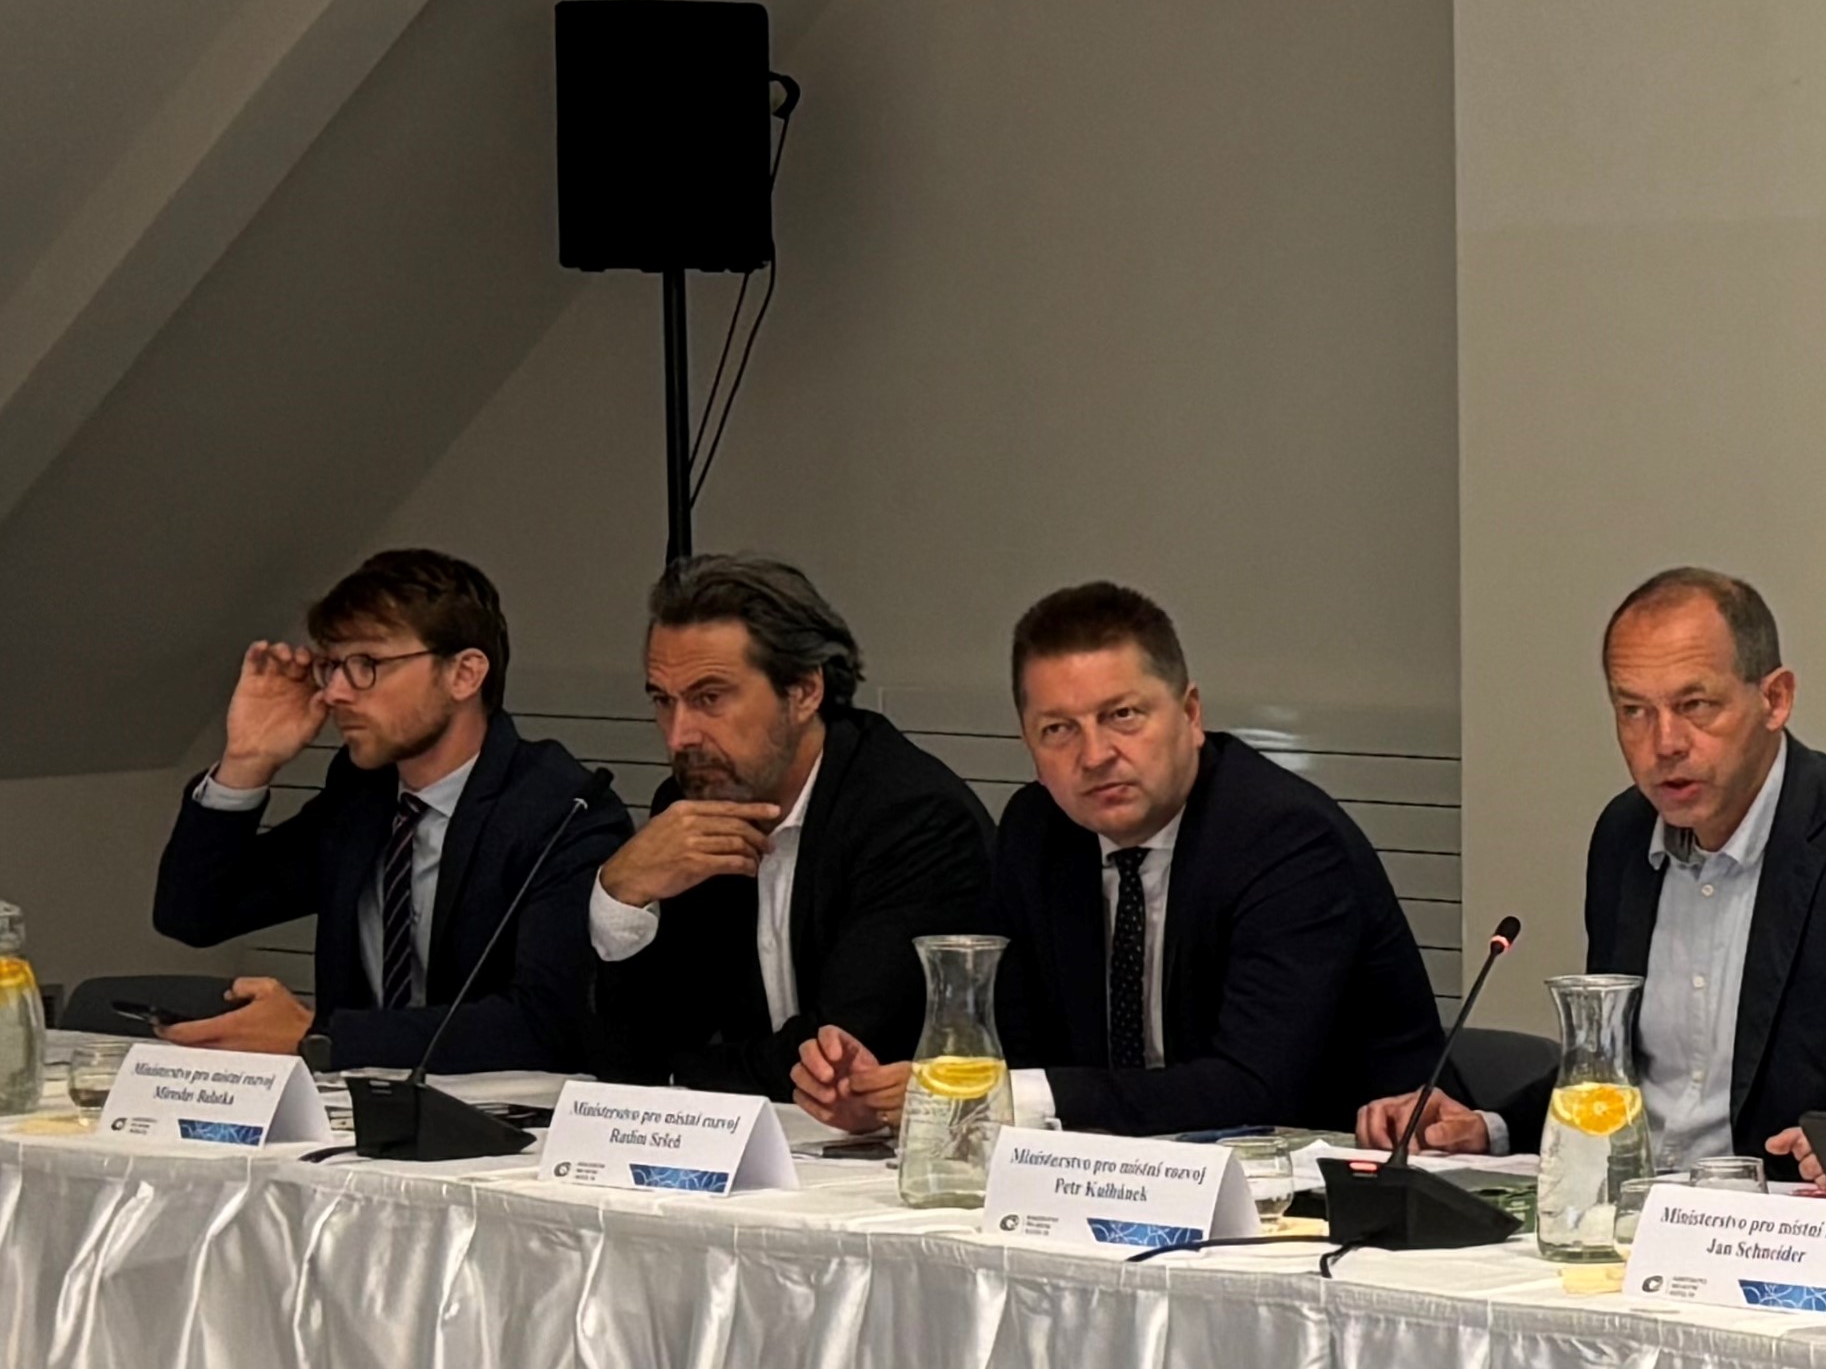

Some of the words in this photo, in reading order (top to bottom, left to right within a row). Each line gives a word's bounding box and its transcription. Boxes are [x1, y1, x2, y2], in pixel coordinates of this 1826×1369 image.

[1093, 1159, 1116, 1175] pro
[1054, 1178, 1081, 1196] Petr
[1661, 1206, 1746, 1230] Ministerstvo
[1749, 1218, 1774, 1235] pro
[1706, 1238, 1731, 1256] Jan
[1735, 1242, 1807, 1263] Schneider
